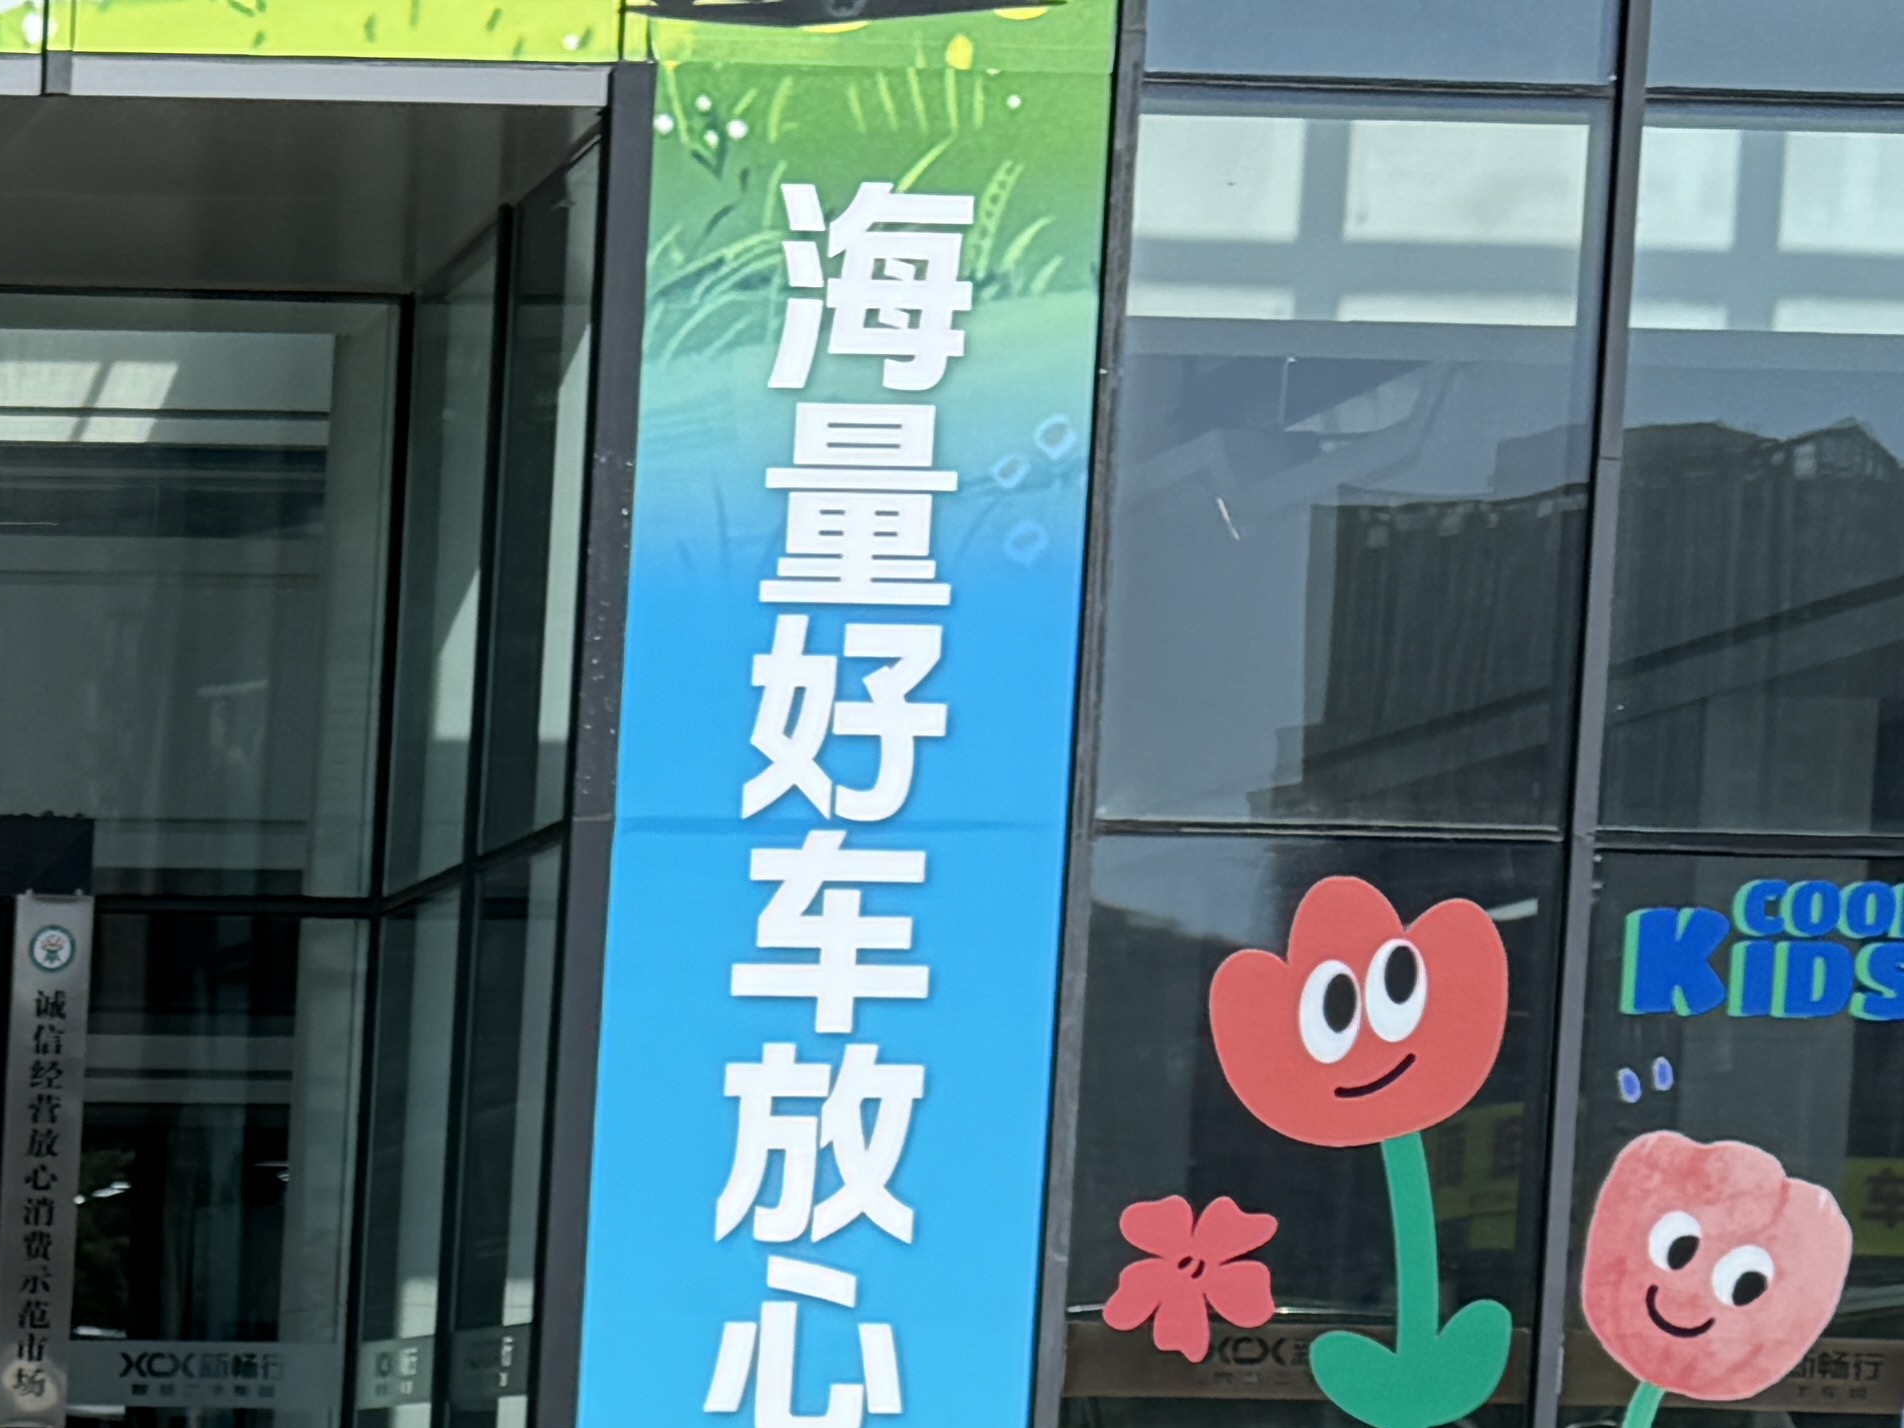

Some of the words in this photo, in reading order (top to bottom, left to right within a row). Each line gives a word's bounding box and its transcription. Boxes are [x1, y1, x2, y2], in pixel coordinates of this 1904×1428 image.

[12, 989, 67, 1398] 诚信经营放心消费示范市场
